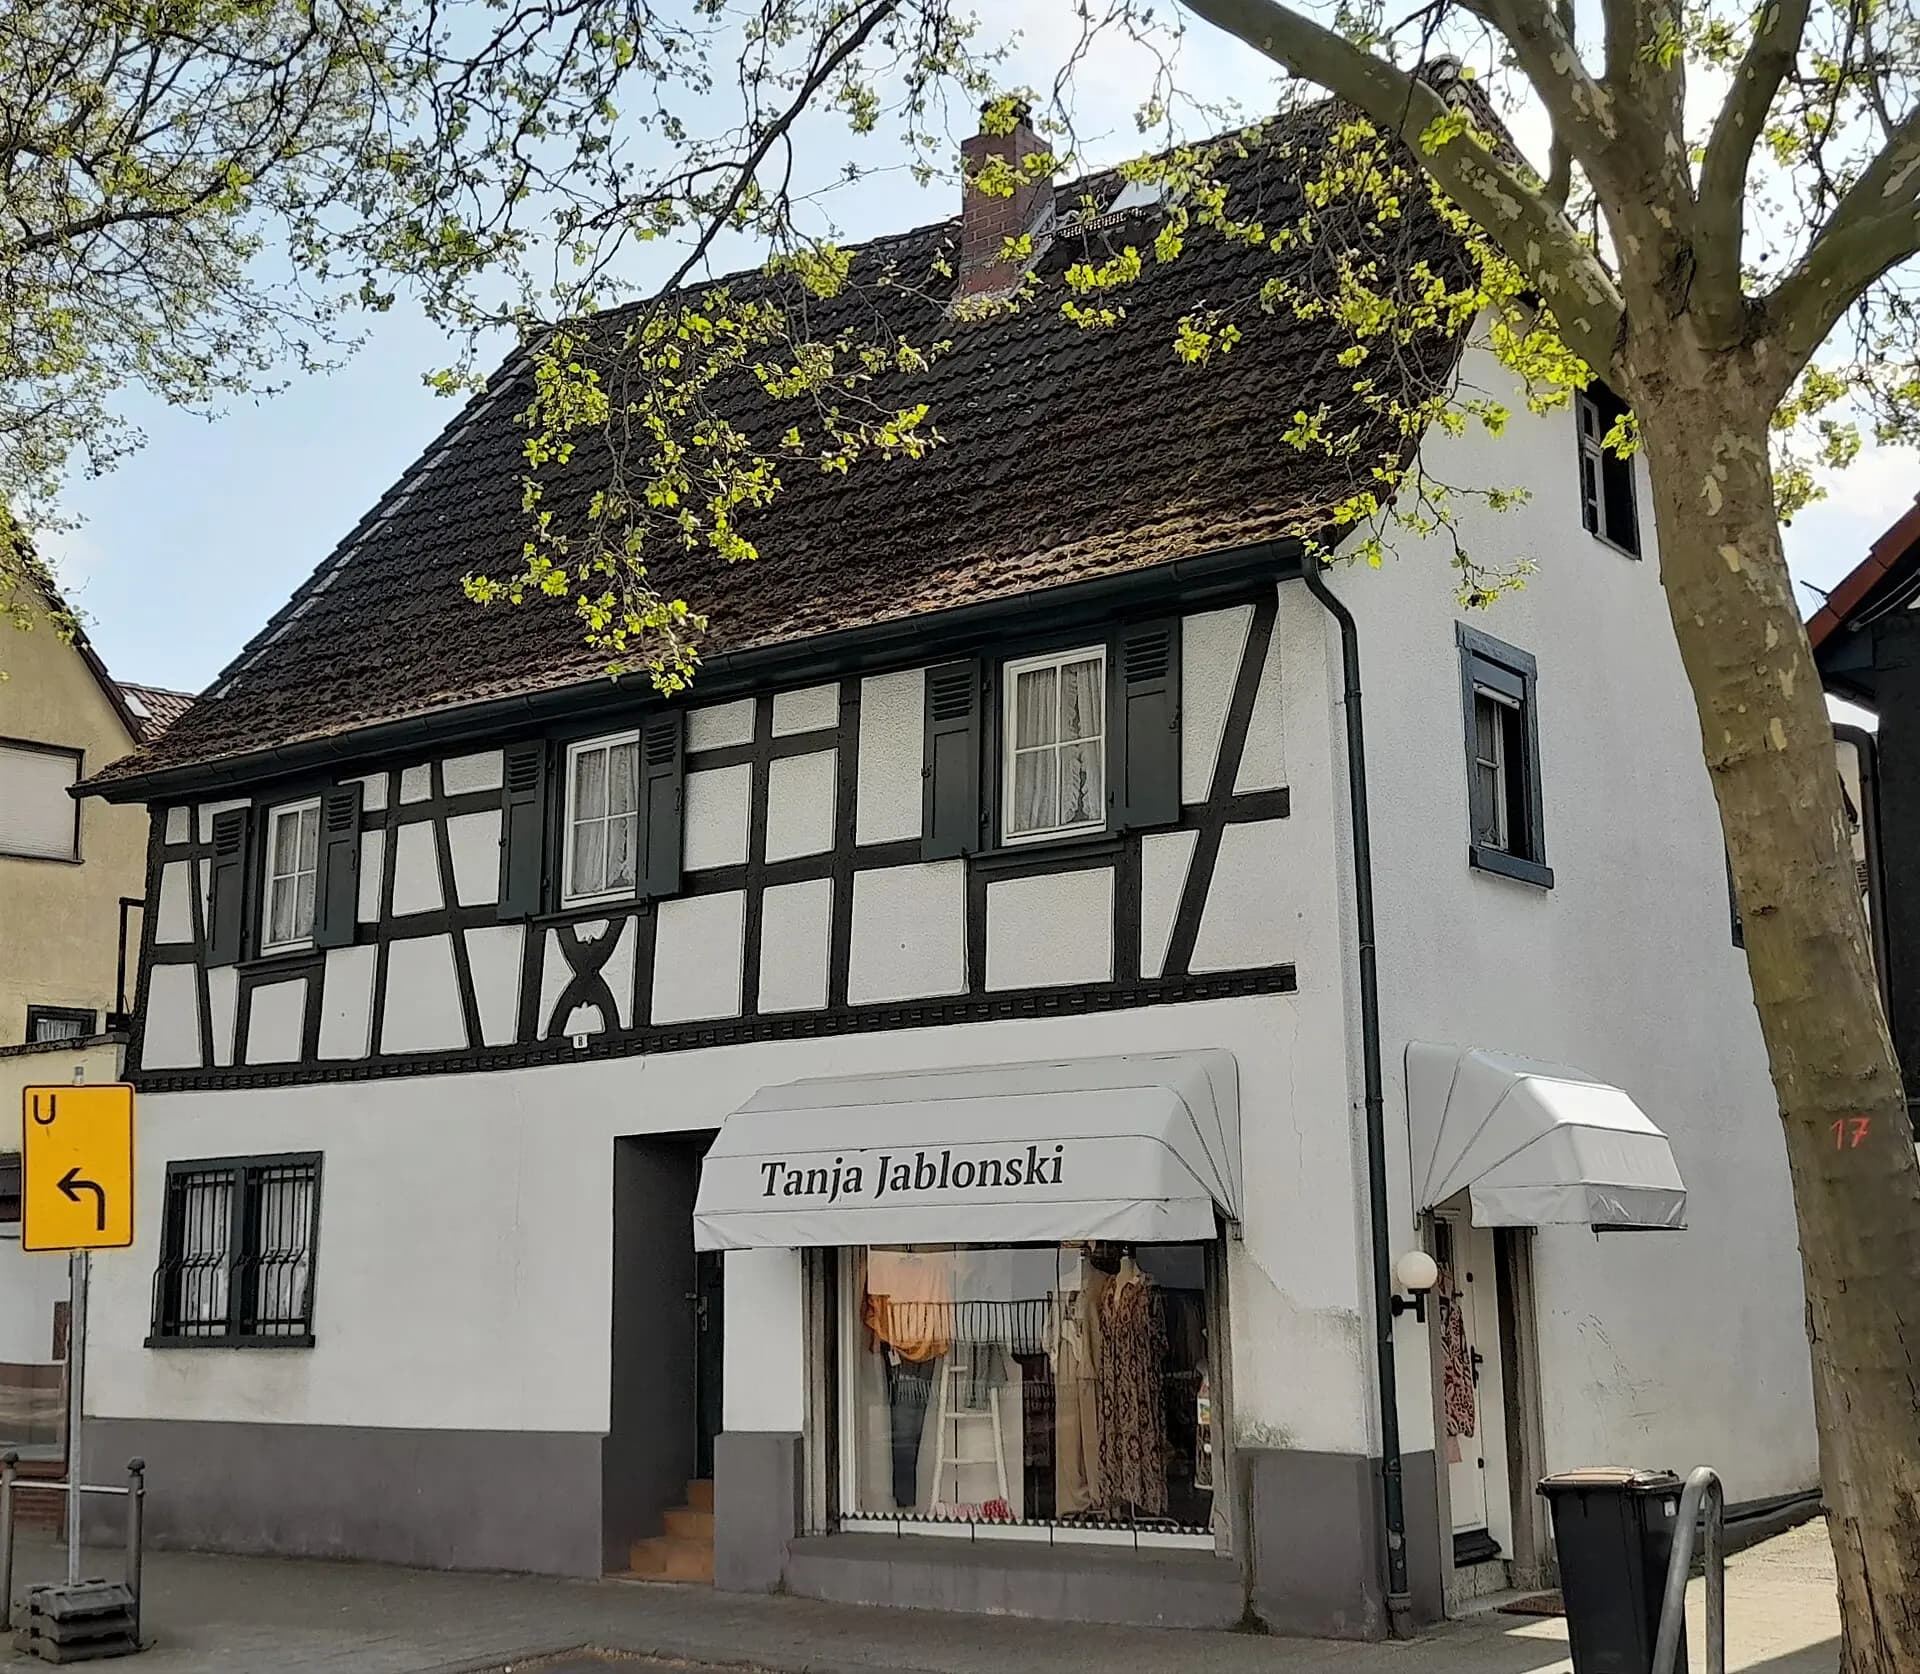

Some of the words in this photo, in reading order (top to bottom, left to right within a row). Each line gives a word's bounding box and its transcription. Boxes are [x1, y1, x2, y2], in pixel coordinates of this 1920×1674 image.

[34, 1094, 56, 1125] U
[1829, 1116, 1871, 1150] 17
[761, 1157, 863, 1204] Tanja
[874, 1144, 1064, 1200] Jablonski
